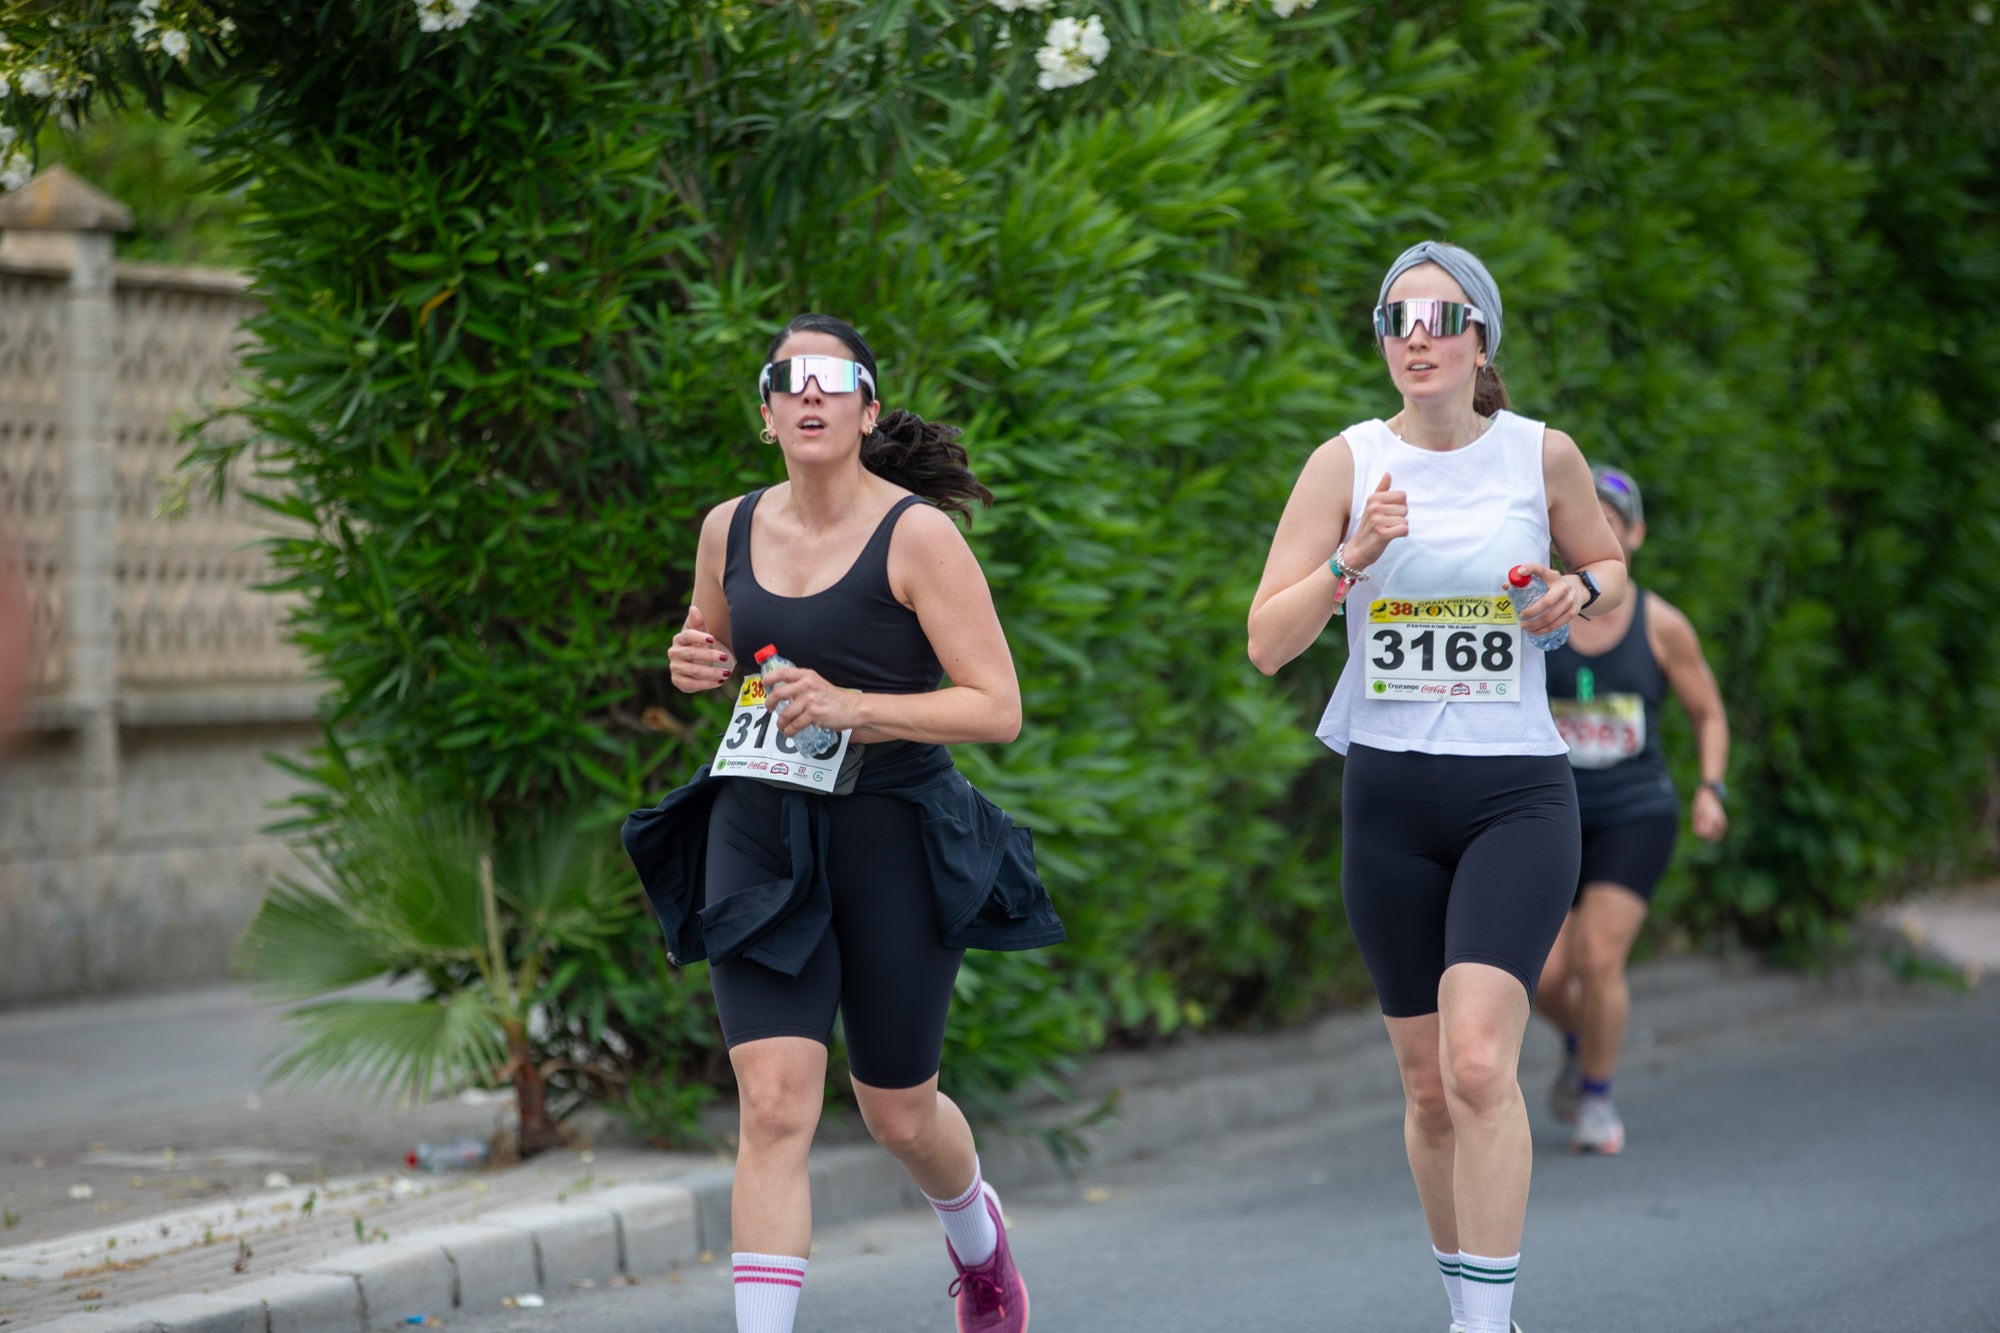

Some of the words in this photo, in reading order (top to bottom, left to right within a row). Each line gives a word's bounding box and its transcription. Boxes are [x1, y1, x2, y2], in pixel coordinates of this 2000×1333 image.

[1389, 601, 1413, 616] 38
[1413, 604, 1490, 618] FONDO
[1372, 630, 1514, 672] 3168
[751, 681, 765, 699] 38
[1388, 682, 1420, 691] Cruzcampo
